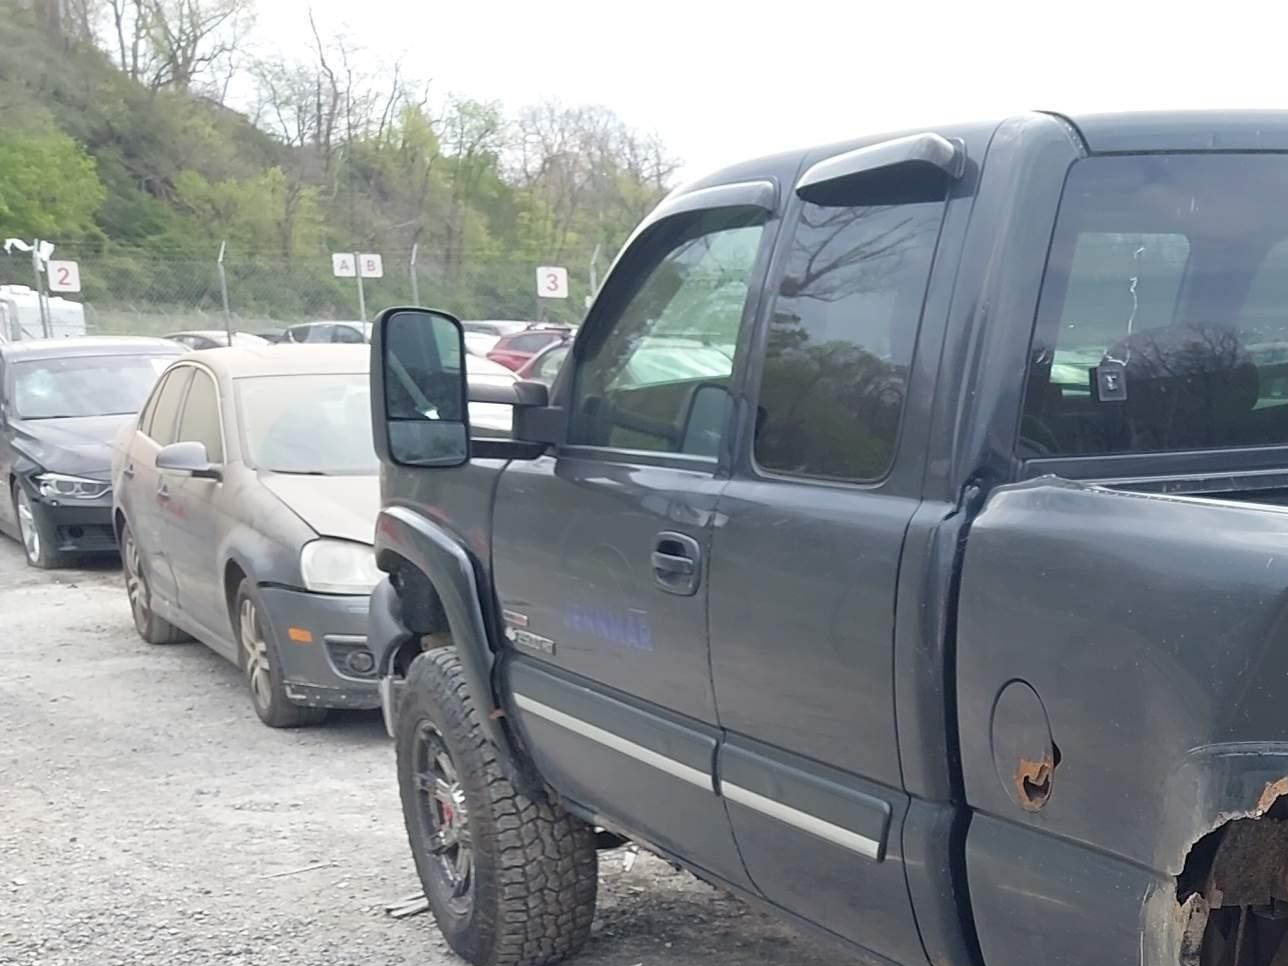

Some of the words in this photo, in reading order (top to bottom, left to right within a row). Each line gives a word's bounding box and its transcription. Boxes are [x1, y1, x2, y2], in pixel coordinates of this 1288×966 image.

[339, 259, 350, 271] A
[367, 260, 377, 272] B
[57, 267, 73, 286] 2
[546, 273, 559, 292] 3
